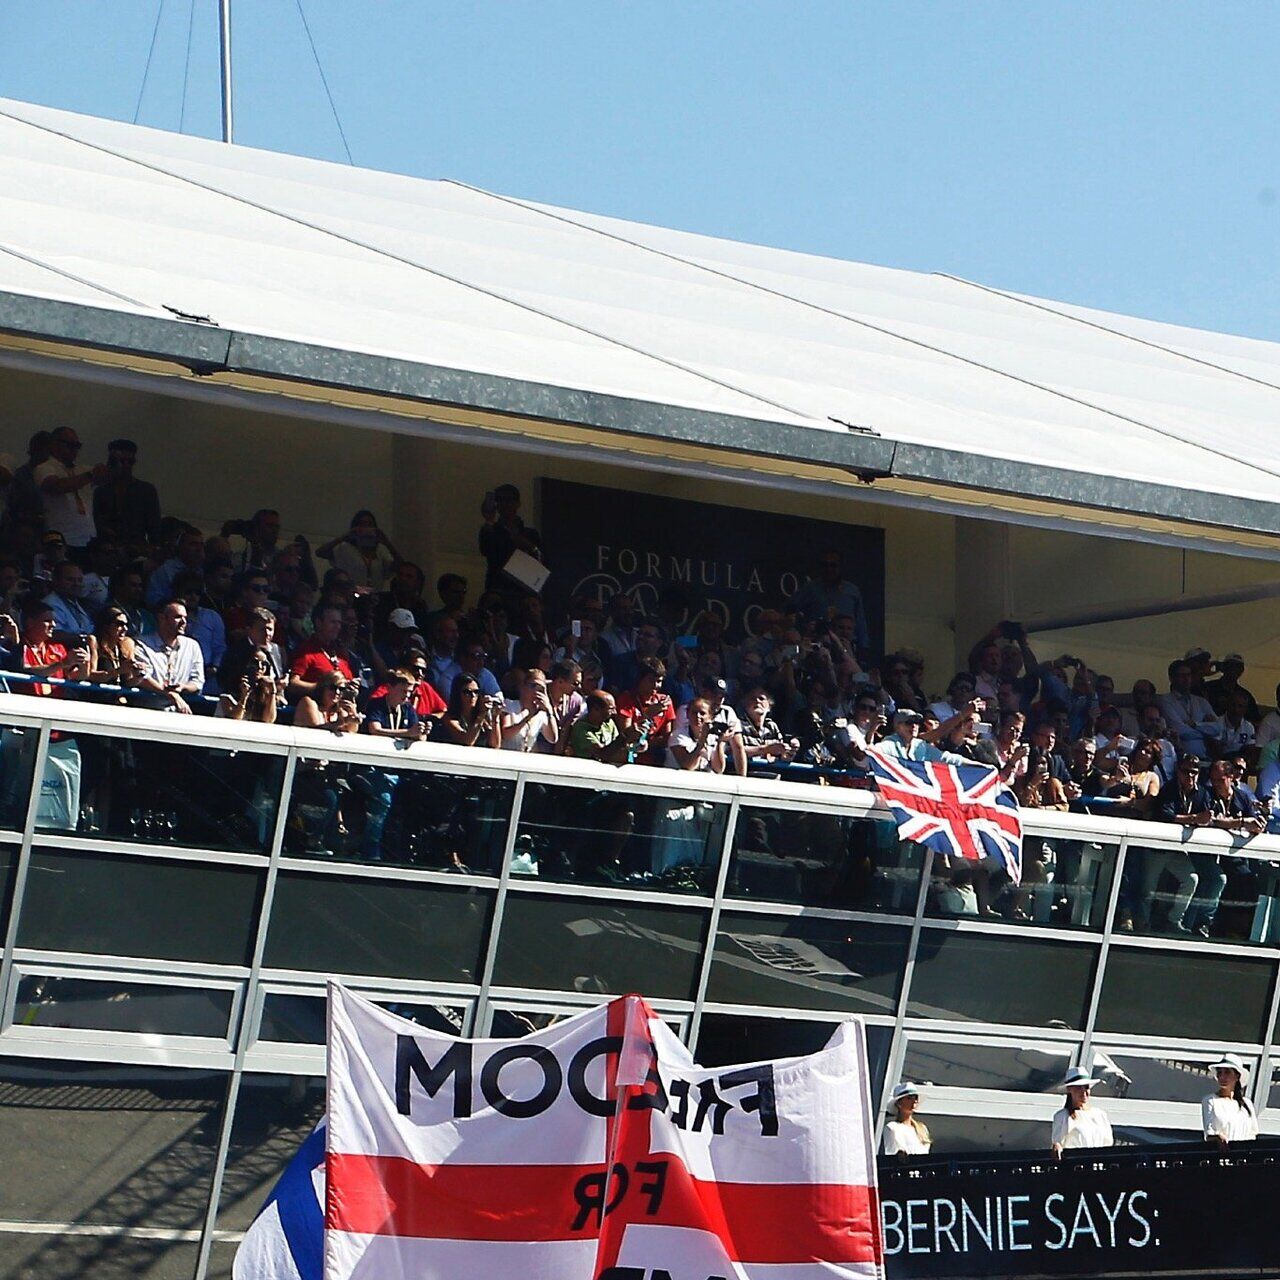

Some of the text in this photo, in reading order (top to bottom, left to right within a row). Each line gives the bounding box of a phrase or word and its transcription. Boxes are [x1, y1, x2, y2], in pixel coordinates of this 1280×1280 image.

[598, 545, 765, 593] FORMULA
[880, 1189, 1161, 1255] BERNIE SAYS:
